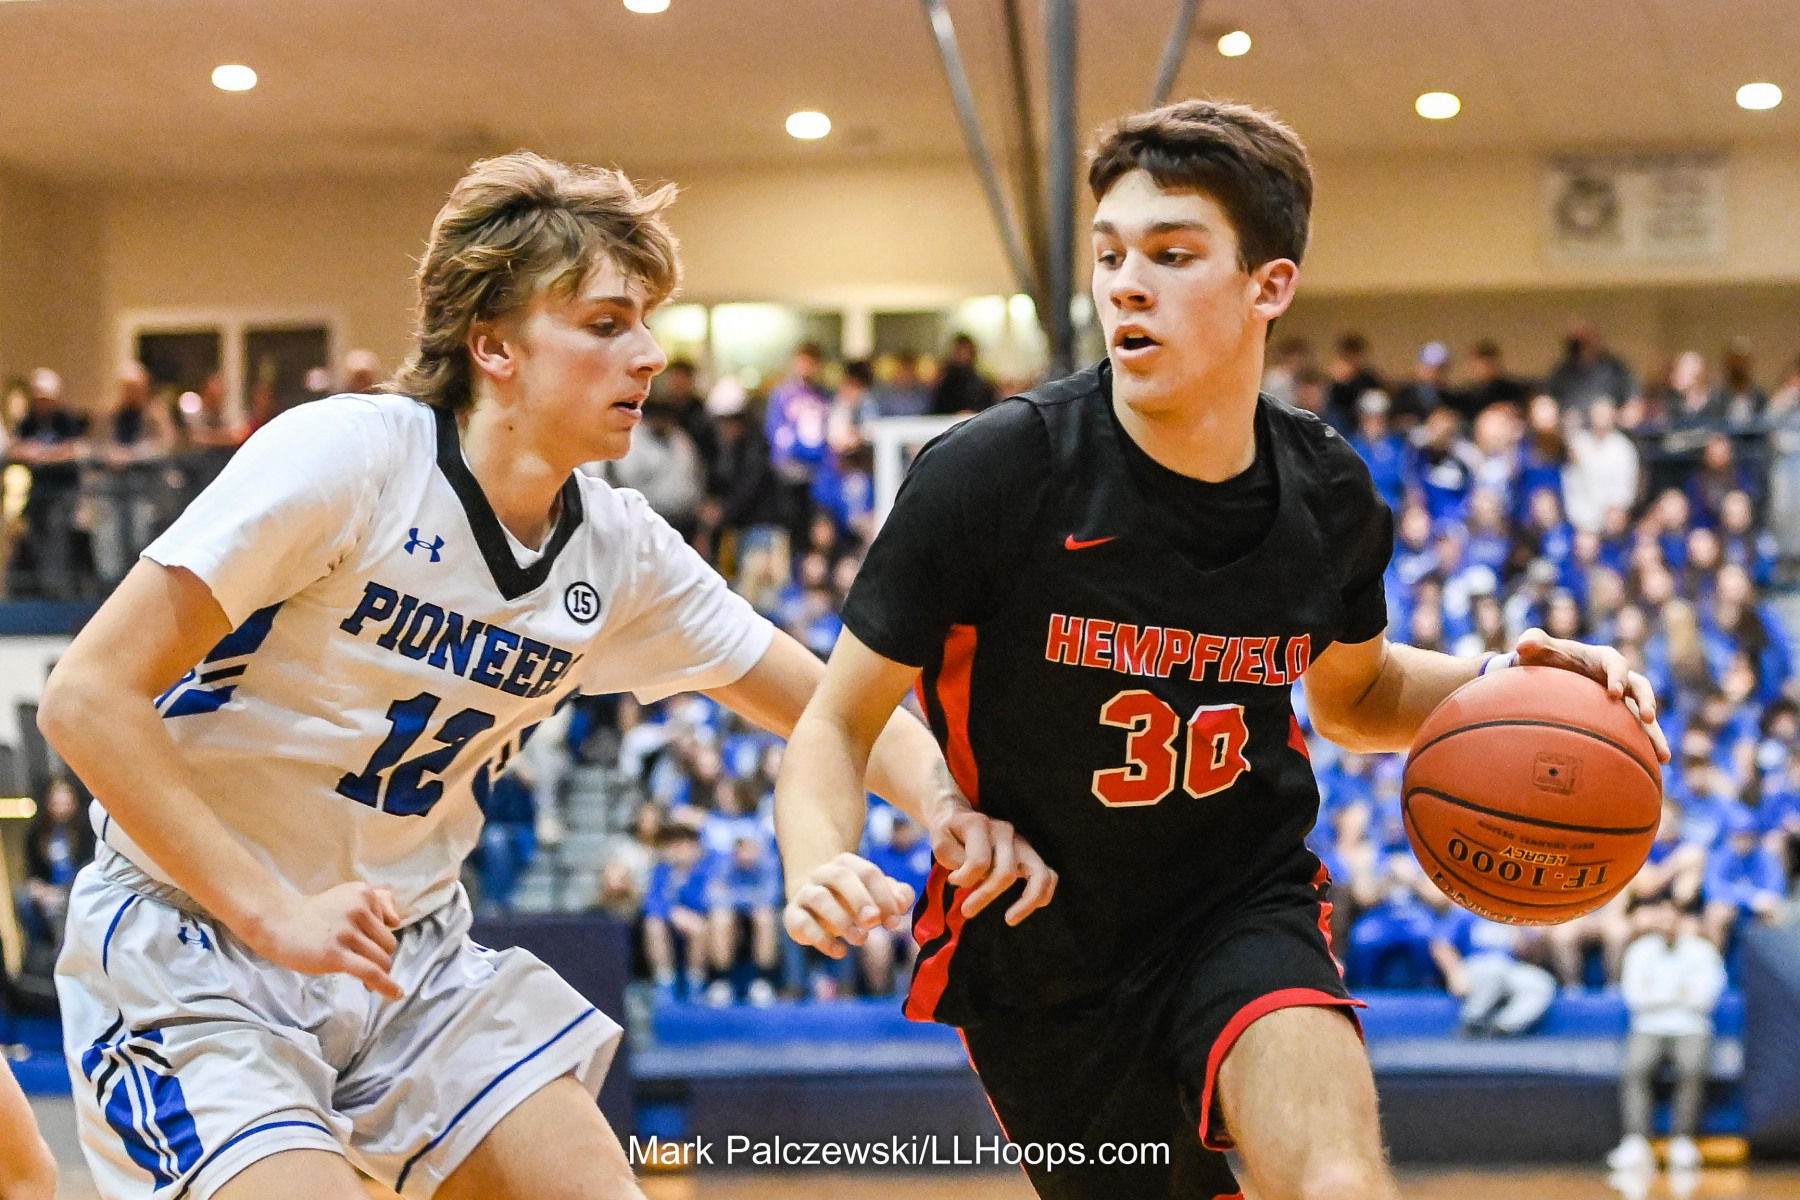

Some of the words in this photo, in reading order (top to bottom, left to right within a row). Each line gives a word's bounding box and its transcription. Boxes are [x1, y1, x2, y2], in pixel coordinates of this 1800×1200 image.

[572, 589, 592, 615] 15
[339, 580, 584, 698] PIONEER
[1045, 613, 1311, 686] HEMPFIELD
[335, 691, 496, 817] 12
[1091, 689, 1251, 807] 30
[1447, 838, 1609, 890] TF-1000
[1499, 845, 1569, 866] LEGACY
